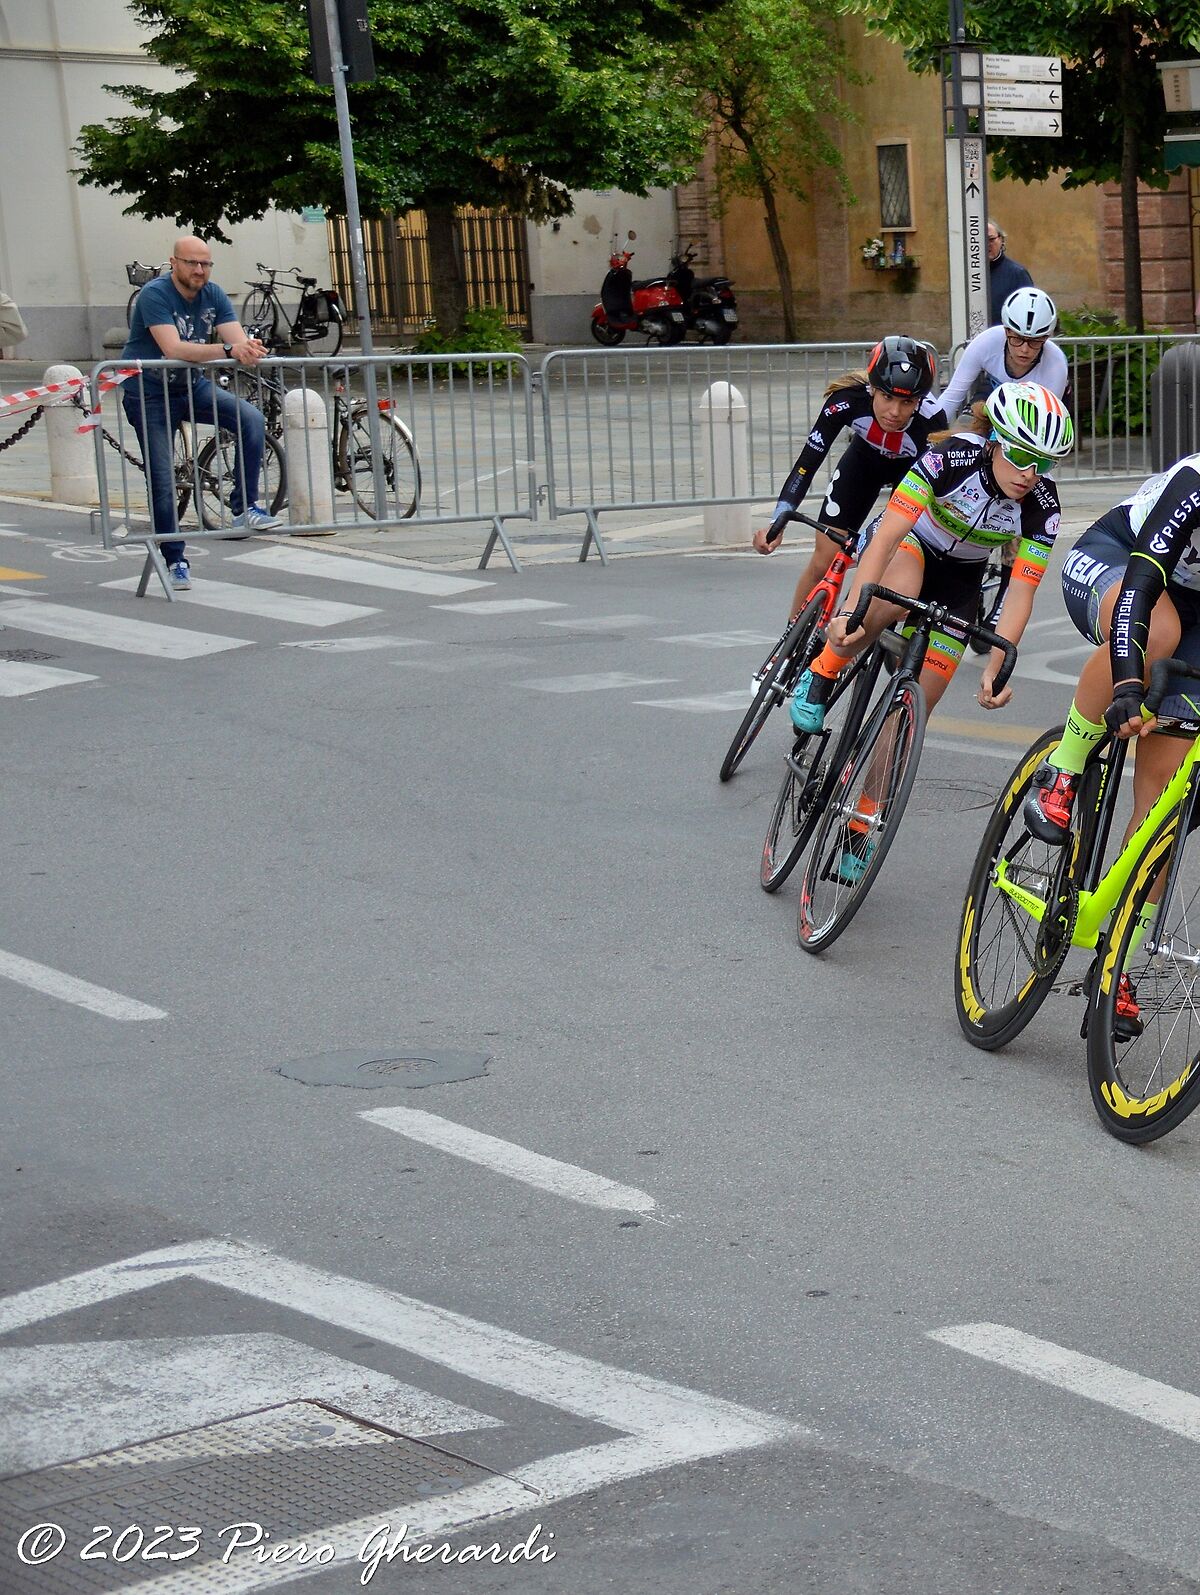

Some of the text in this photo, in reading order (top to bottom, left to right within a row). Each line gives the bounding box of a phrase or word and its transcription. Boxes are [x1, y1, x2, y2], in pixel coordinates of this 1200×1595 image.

[969, 215, 981, 292] VIA RASPONI
[1044, 491, 1058, 509] LIFT
[1116, 589, 1136, 658] PAGLIACCIA
